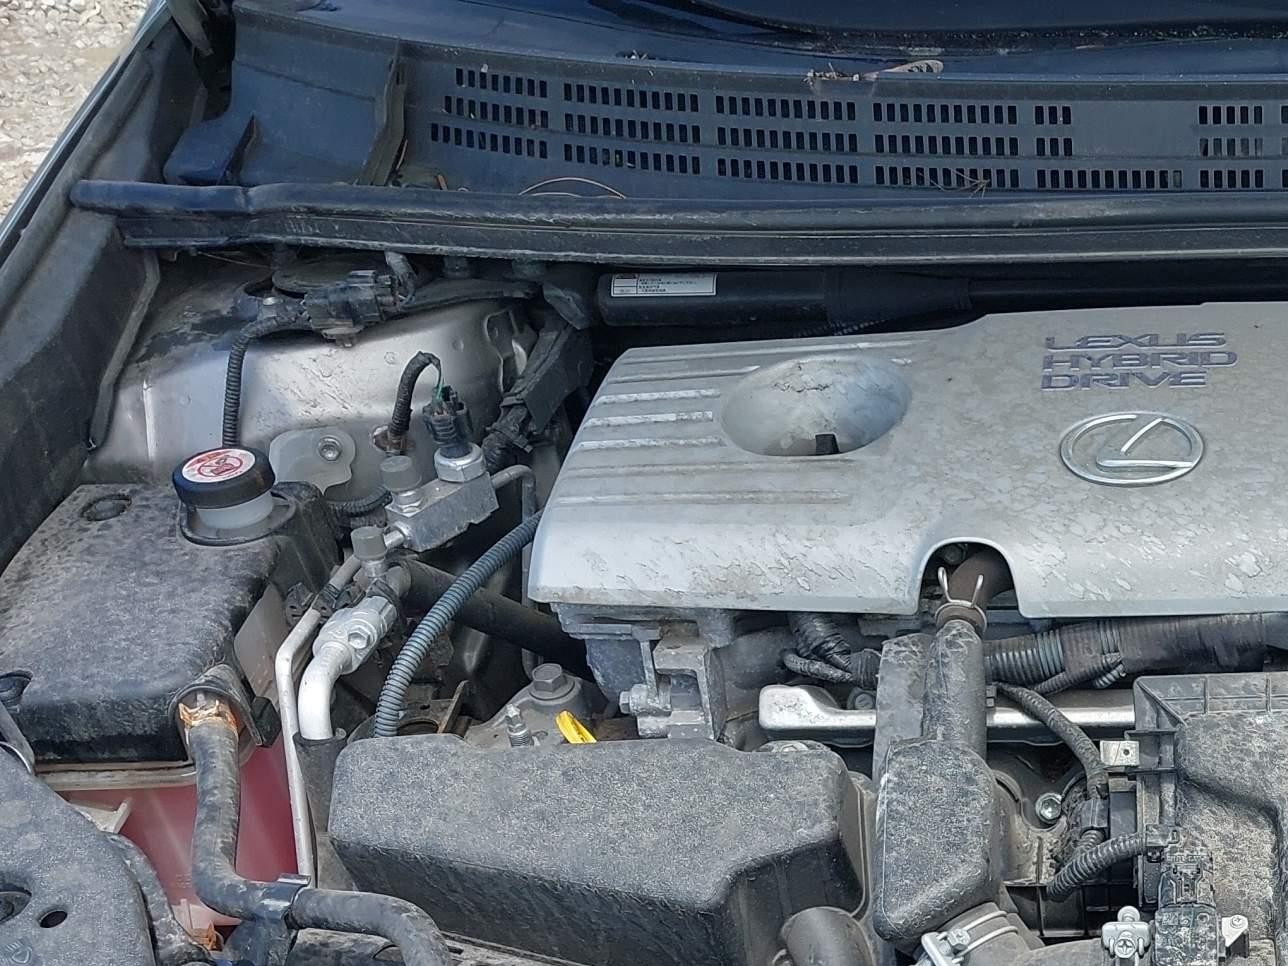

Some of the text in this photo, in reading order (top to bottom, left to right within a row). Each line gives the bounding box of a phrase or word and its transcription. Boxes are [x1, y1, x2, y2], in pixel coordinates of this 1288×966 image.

[1045, 333, 1227, 351] LEXUS
[1043, 352, 1237, 371] HYBRID
[1041, 371, 1207, 391] DRIVE
